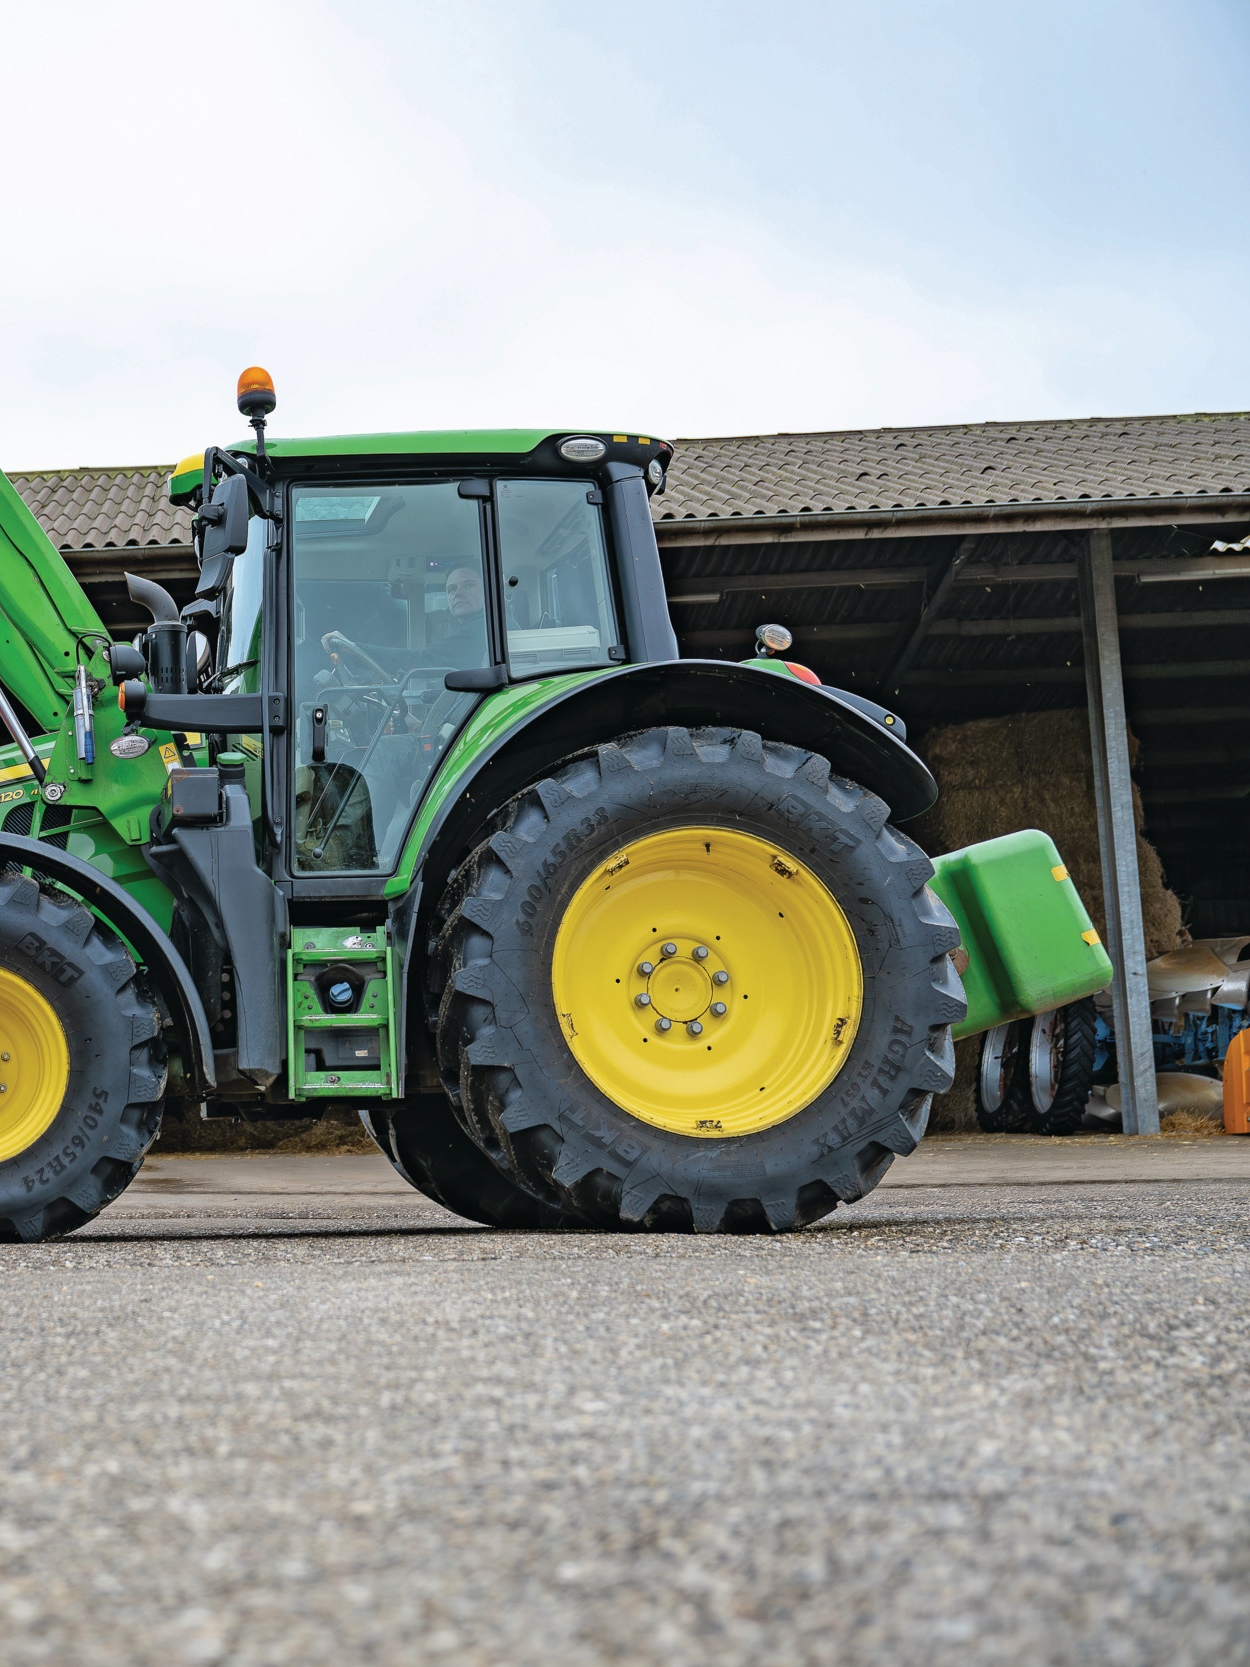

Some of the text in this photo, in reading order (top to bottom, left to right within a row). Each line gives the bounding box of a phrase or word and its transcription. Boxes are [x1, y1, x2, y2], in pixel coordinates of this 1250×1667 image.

[775, 797, 857, 854] BKT
[514, 806, 609, 937] 600/65R38
[16, 933, 81, 983] BKT
[21, 1086, 110, 1194] 540/65R24
[562, 1105, 646, 1163] BKT
